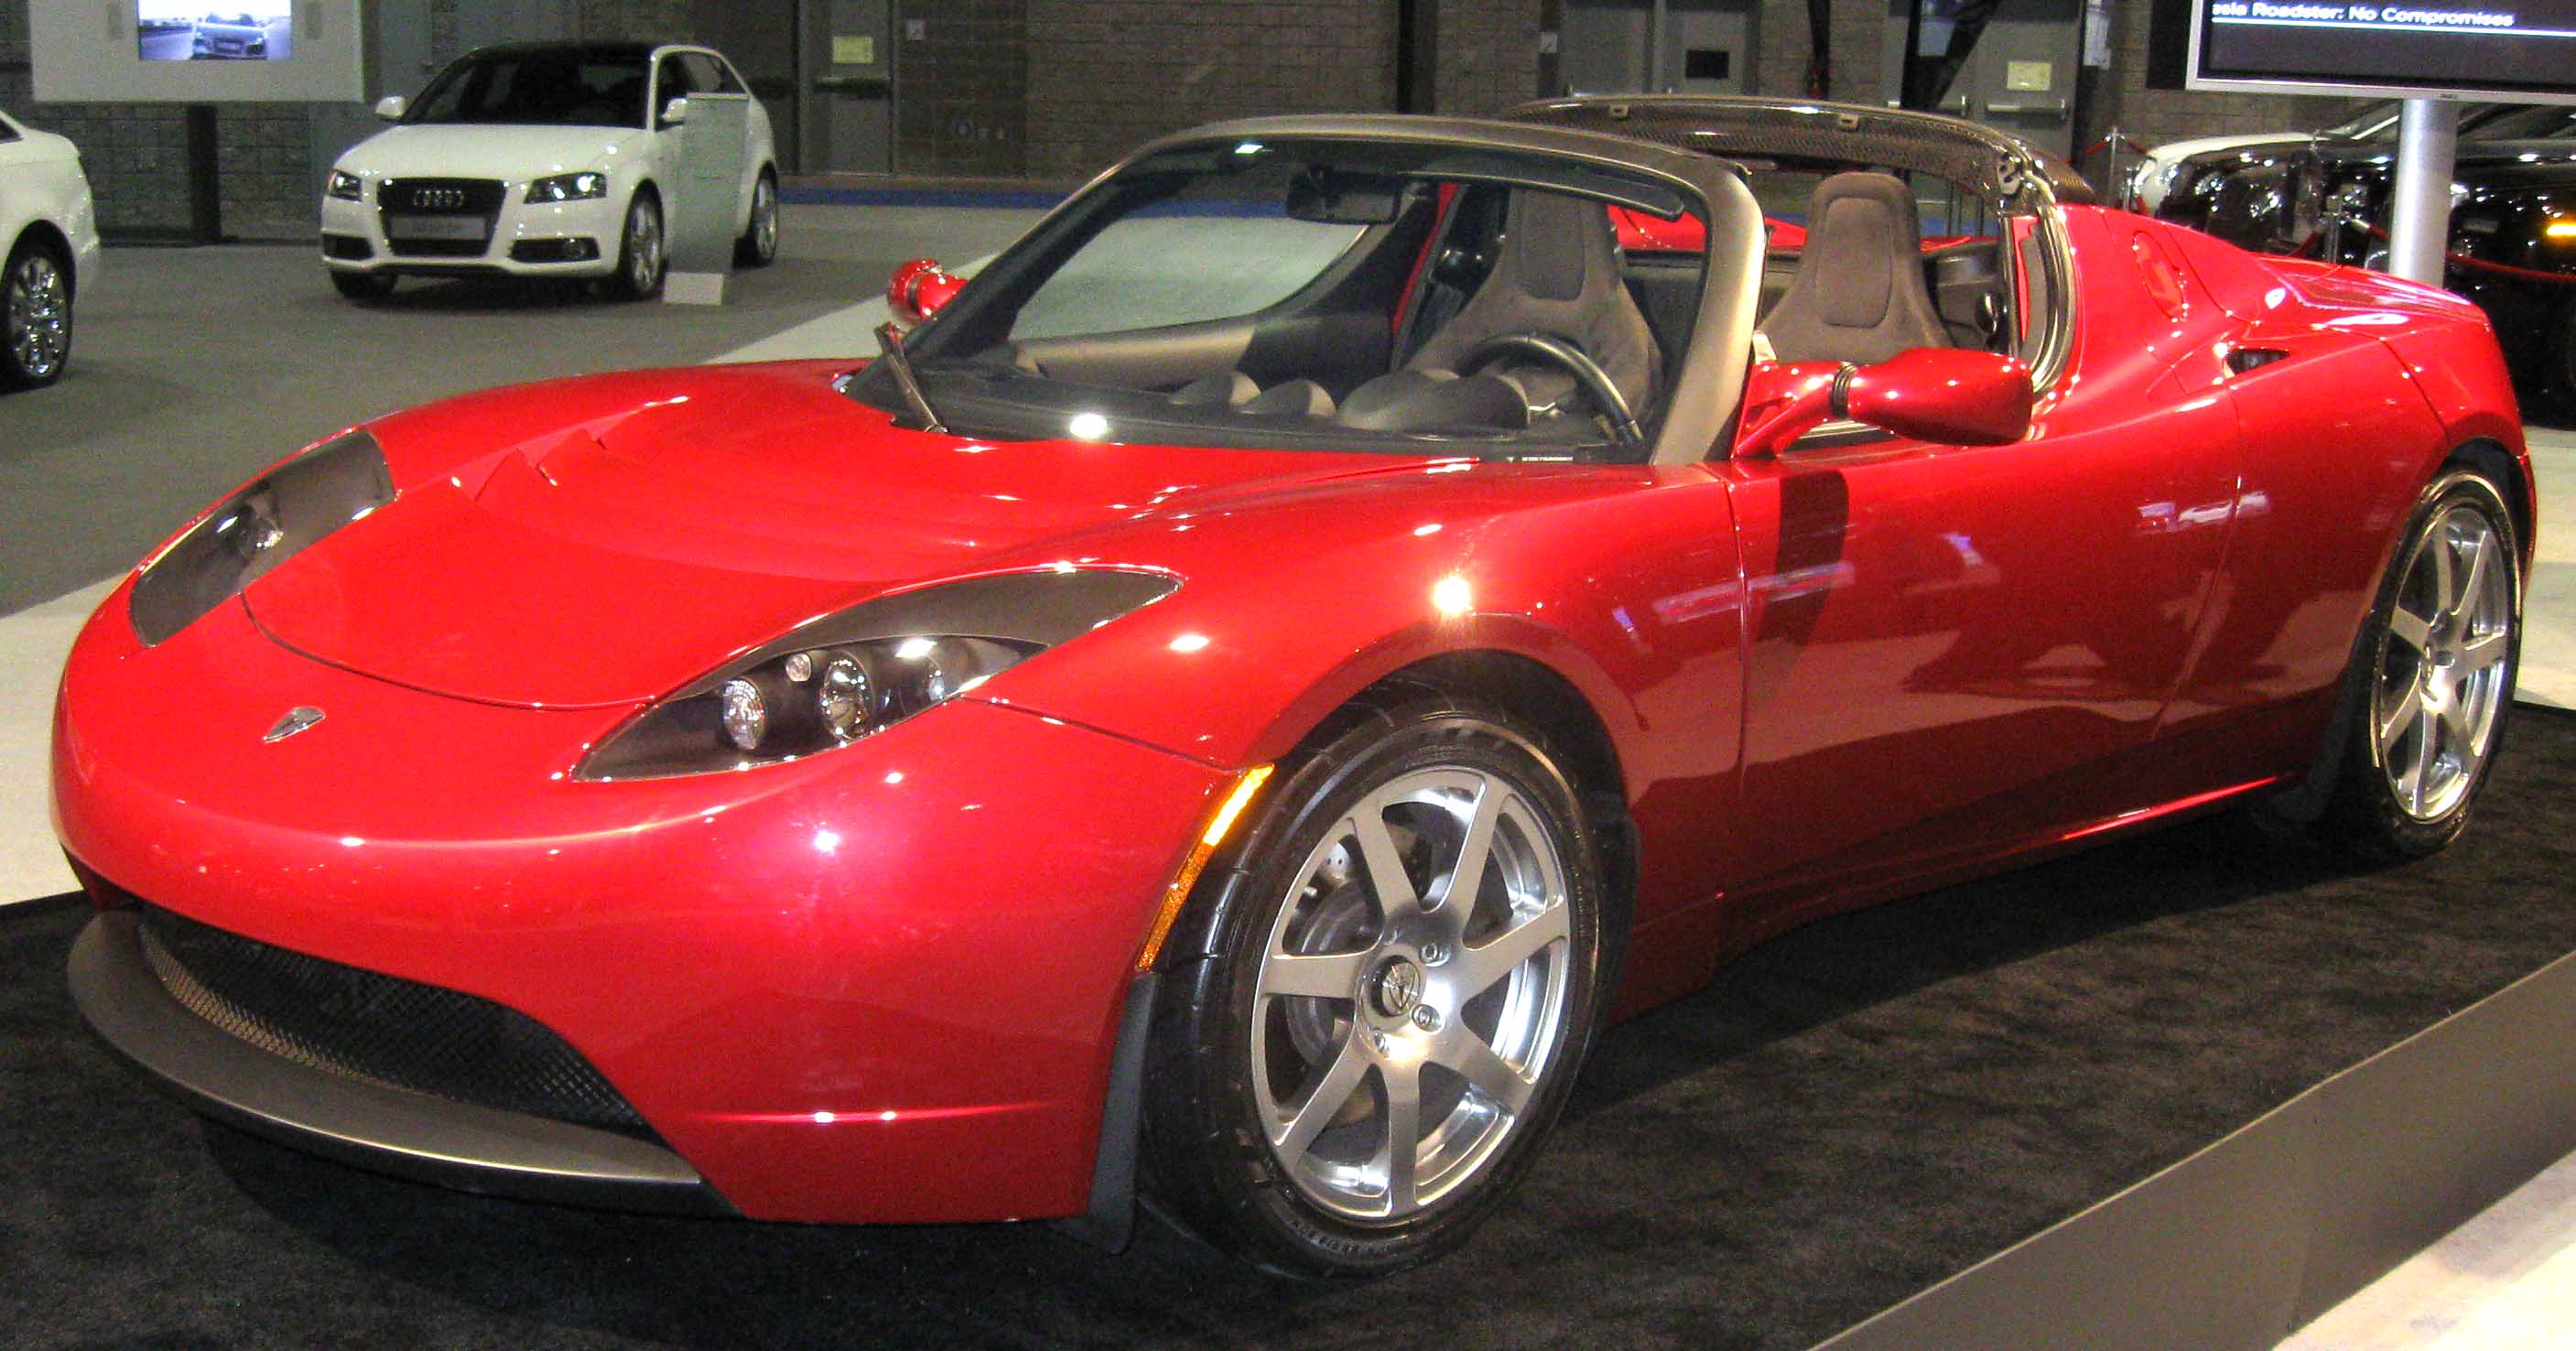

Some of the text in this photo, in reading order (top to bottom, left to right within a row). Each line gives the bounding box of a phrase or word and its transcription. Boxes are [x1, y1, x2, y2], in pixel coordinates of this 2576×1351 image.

[2252, 2, 2343, 19] Roadster:
[2349, 6, 2377, 20] No
[2381, 7, 2514, 27] Compromises
